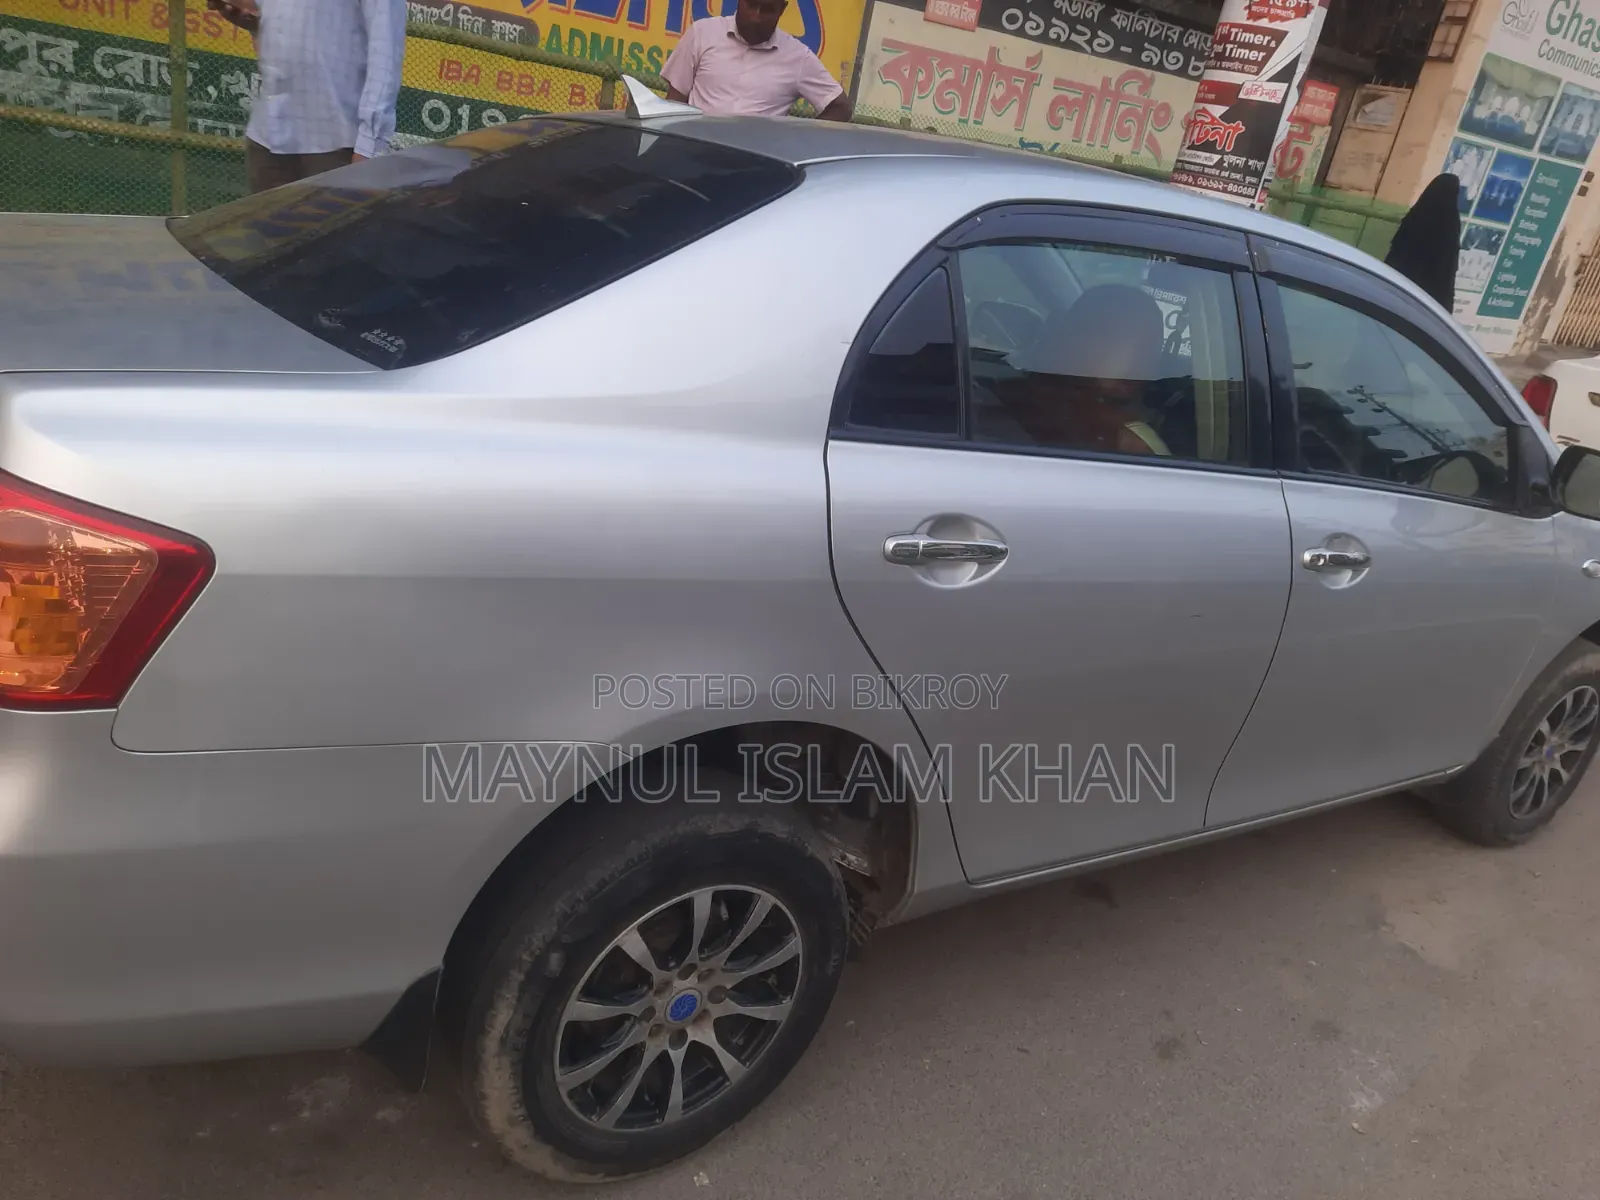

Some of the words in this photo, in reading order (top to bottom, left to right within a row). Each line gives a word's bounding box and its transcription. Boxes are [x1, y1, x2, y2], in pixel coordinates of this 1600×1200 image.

[1229, 27, 1271, 46] Timer
[1225, 43, 1266, 61] Timer
[439, 57, 481, 86] IBA
[496, 70, 550, 98] BBA
[1222, 154, 1247, 168] খুলনা
